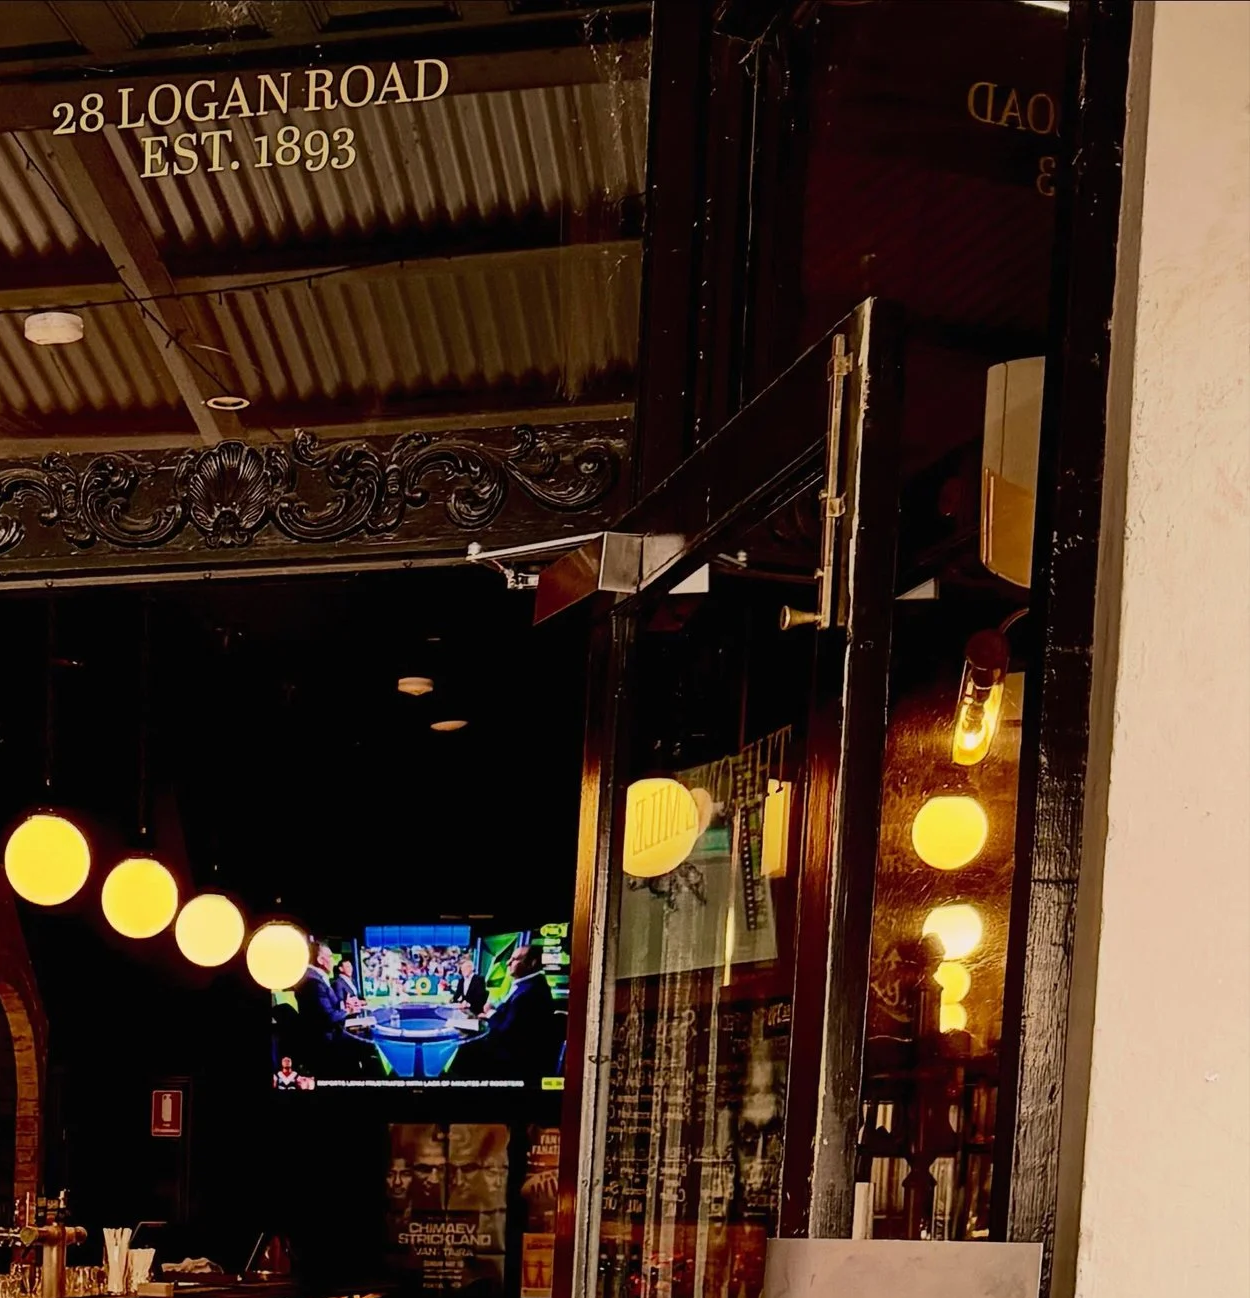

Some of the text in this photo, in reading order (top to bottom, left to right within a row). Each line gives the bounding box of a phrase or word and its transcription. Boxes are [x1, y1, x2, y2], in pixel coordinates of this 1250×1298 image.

[52, 58, 449, 135] 28 LOGAN ROAD
[140, 126, 356, 178] EST. 1893
[398, 1233, 491, 1246] STRICKLAND
[409, 1222, 476, 1234] CHIMAEV
